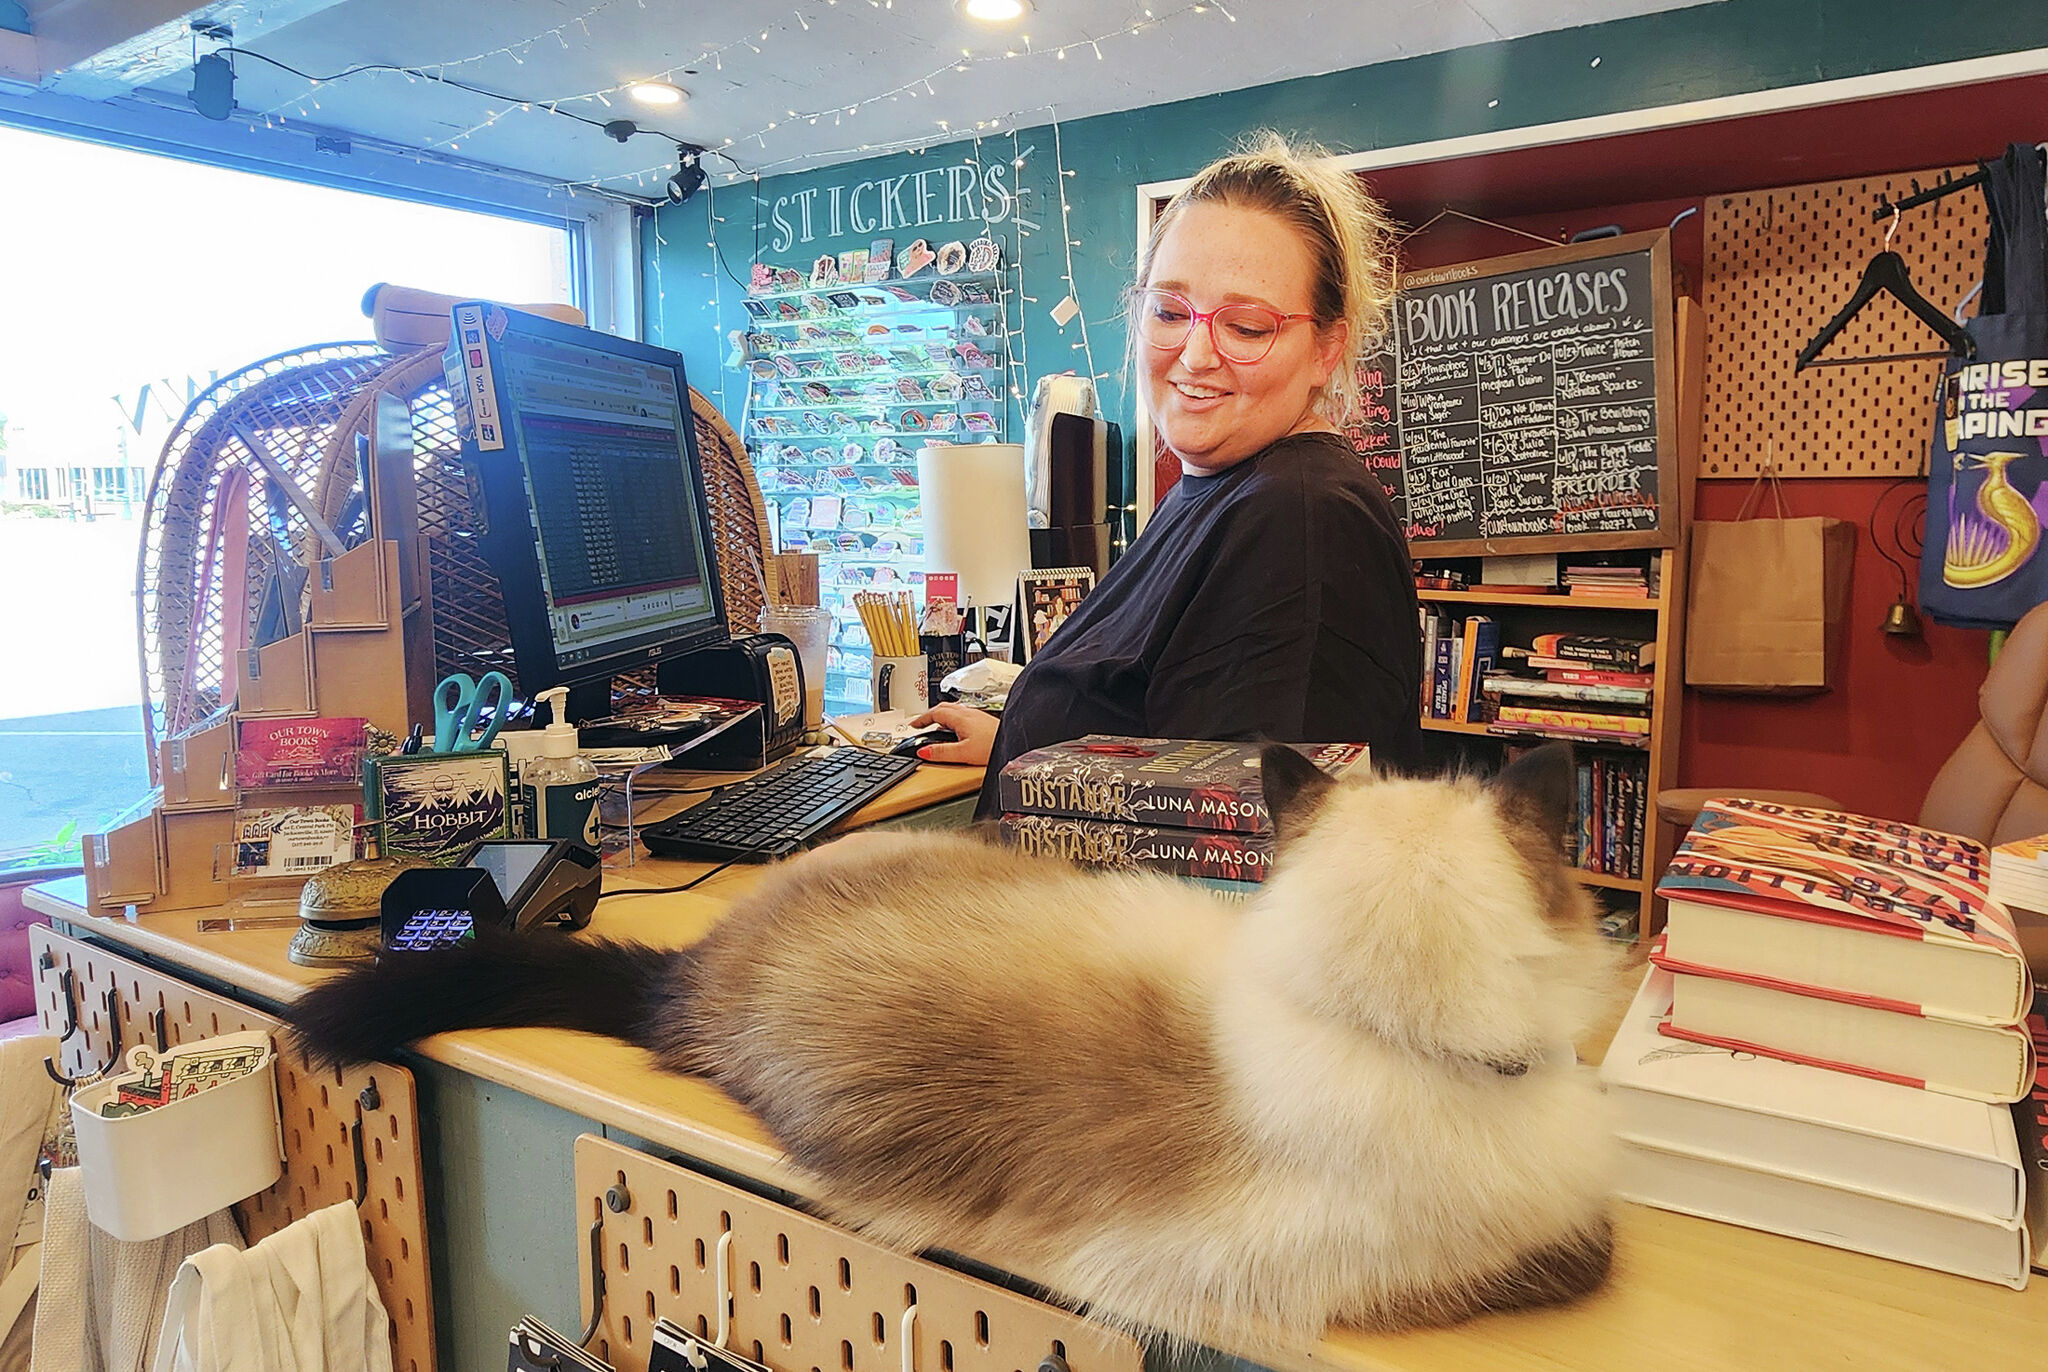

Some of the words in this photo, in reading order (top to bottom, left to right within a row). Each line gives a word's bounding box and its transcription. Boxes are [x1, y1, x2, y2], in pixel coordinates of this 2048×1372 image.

[771, 163, 1012, 253] STICKERS
[1403, 265, 1478, 290] @ourtownbooks
[1405, 287, 1479, 346] BOOK
[1471, 339, 1487, 349] our
[1533, 331, 1548, 341] are
[1506, 353, 1538, 366] Summer
[1539, 351, 1552, 363] Do
[475, 374, 485, 394] VISA
[1453, 369, 1470, 380] Reid
[1512, 404, 1527, 415] Not
[1968, 391, 2011, 409] THE
[1600, 444, 1627, 459] Poppy
[830, 467, 855, 478] PAWS
[1557, 471, 1641, 494] PREORDER
[1590, 653, 1613, 661] SILENCE
[1440, 680, 1449, 703] SPEAKER
[1434, 695, 1442, 709] DEAD
[1440, 703, 1448, 715] FOR
[269, 726, 294, 741] OUR
[296, 725, 330, 739] TOWN
[279, 737, 318, 747] BOOKS
[321, 769, 338, 777] More
[1021, 779, 1126, 814] DISTANCE
[1147, 795, 1194, 813] LUNA
[1199, 798, 1268, 818] MASON
[414, 810, 488, 830] HOBBIT
[1725, 799, 1983, 854] ANDERSON
[1020, 828, 1127, 862] DISTANCE
[1150, 844, 1198, 861] LUNA
[1203, 848, 1274, 867] MASON
[1824, 827, 1980, 867] HALSE
[1668, 862, 1978, 934] REBELLION
[1854, 876, 1971, 915] 1776
